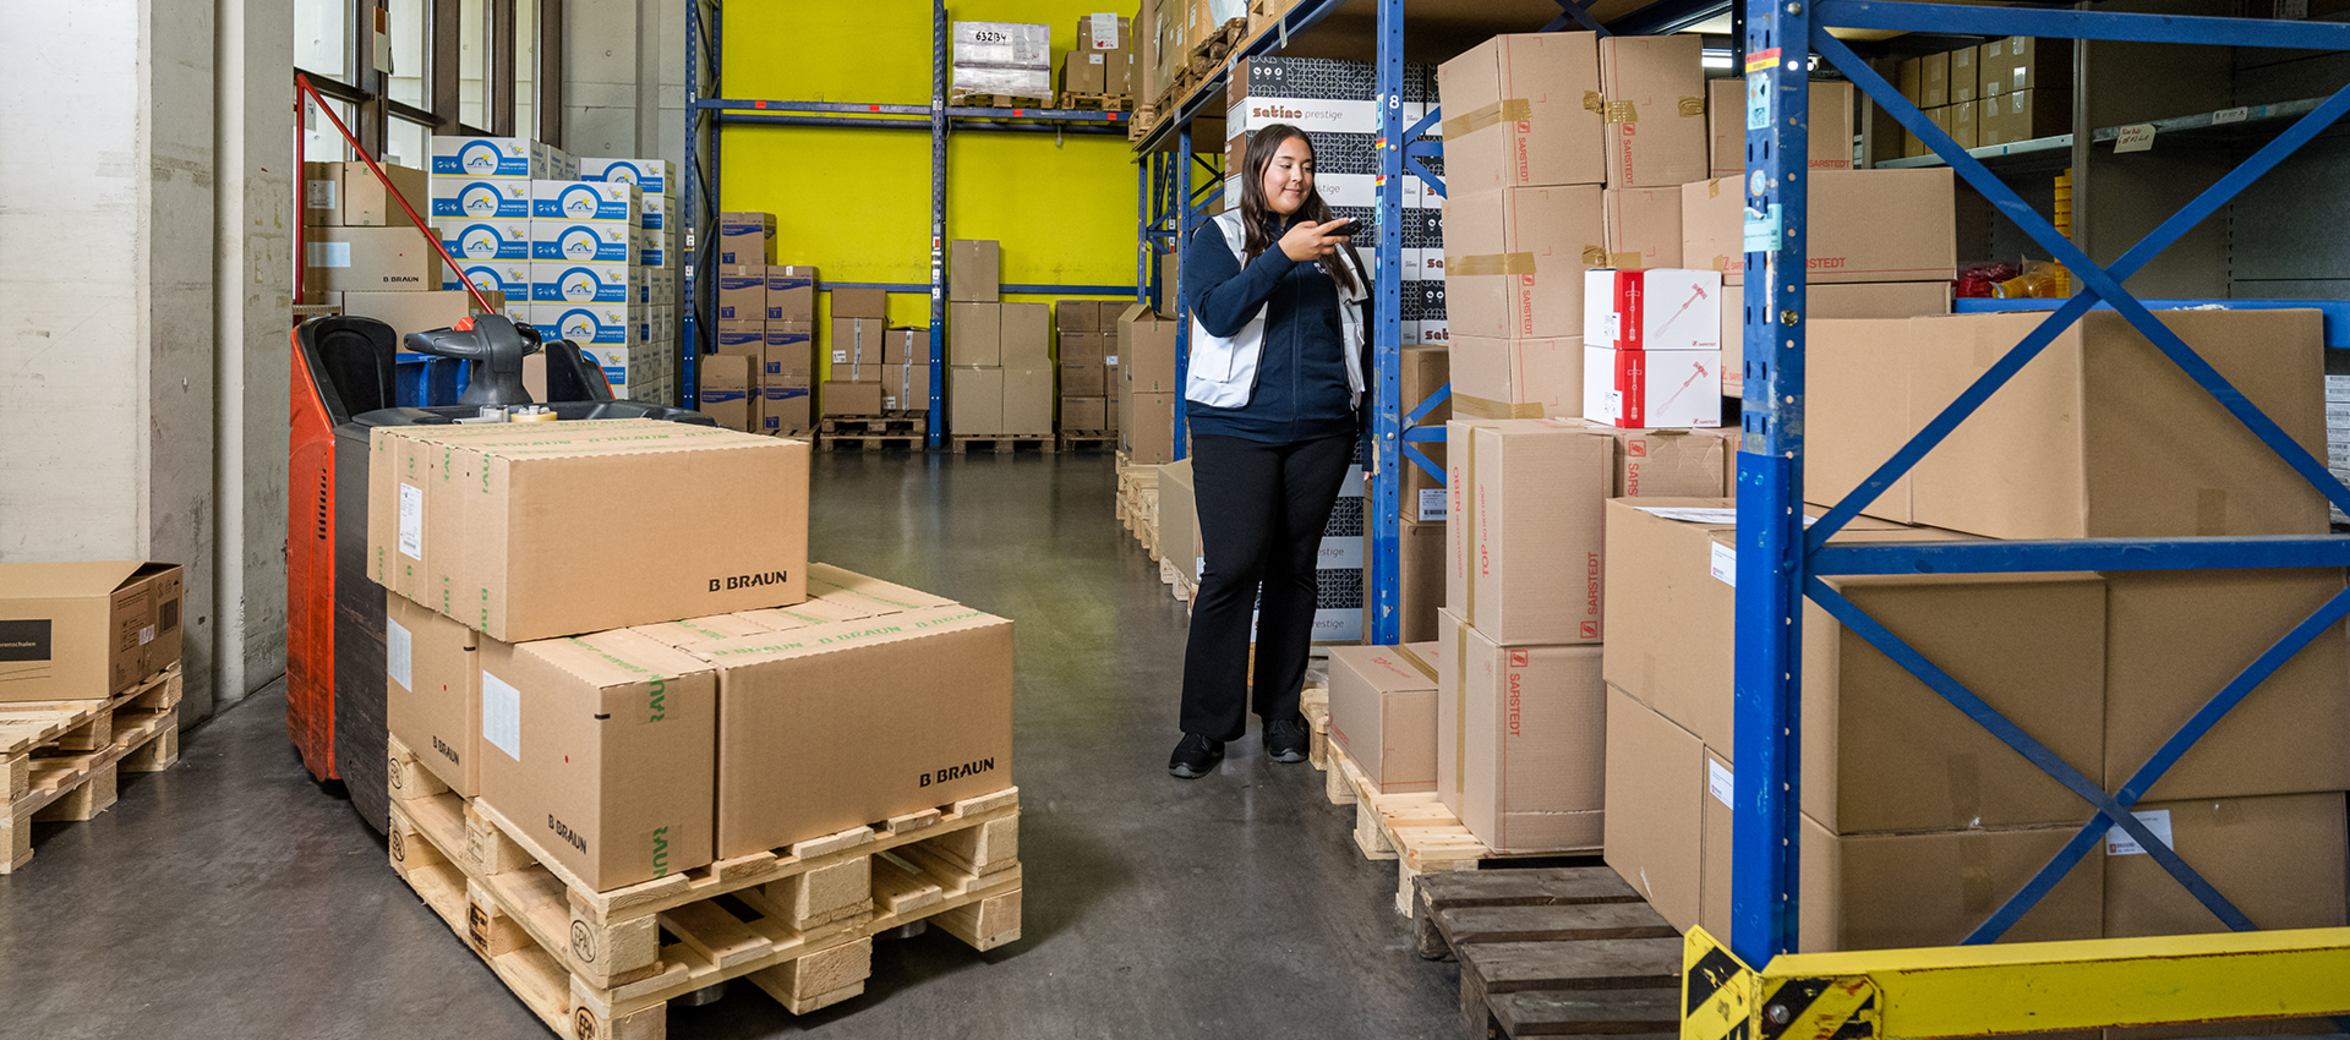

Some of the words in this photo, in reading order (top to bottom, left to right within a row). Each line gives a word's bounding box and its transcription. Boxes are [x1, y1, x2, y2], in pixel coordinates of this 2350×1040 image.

[1252, 105, 1302, 119] satino
[1304, 110, 1343, 121] prestige
[1389, 94, 1399, 109] 8
[1518, 137, 1529, 183] SARSTEDT
[1622, 139, 1634, 184] SARSTEDT
[1522, 290, 1533, 335] SARSTEDT
[1453, 467, 1461, 512] OBEN
[1628, 462, 1639, 497] SARS
[1481, 544, 1489, 578] TOP
[727, 570, 787, 590] BRAUN
[1587, 551, 1598, 615] SARSTEDT
[836, 625, 902, 641] BRAUN
[1509, 673, 1520, 737] SARSTEDT
[438, 740, 460, 766] BRAUN
[937, 757, 994, 784] BRAUN
[556, 819, 586, 855] BRAUN
